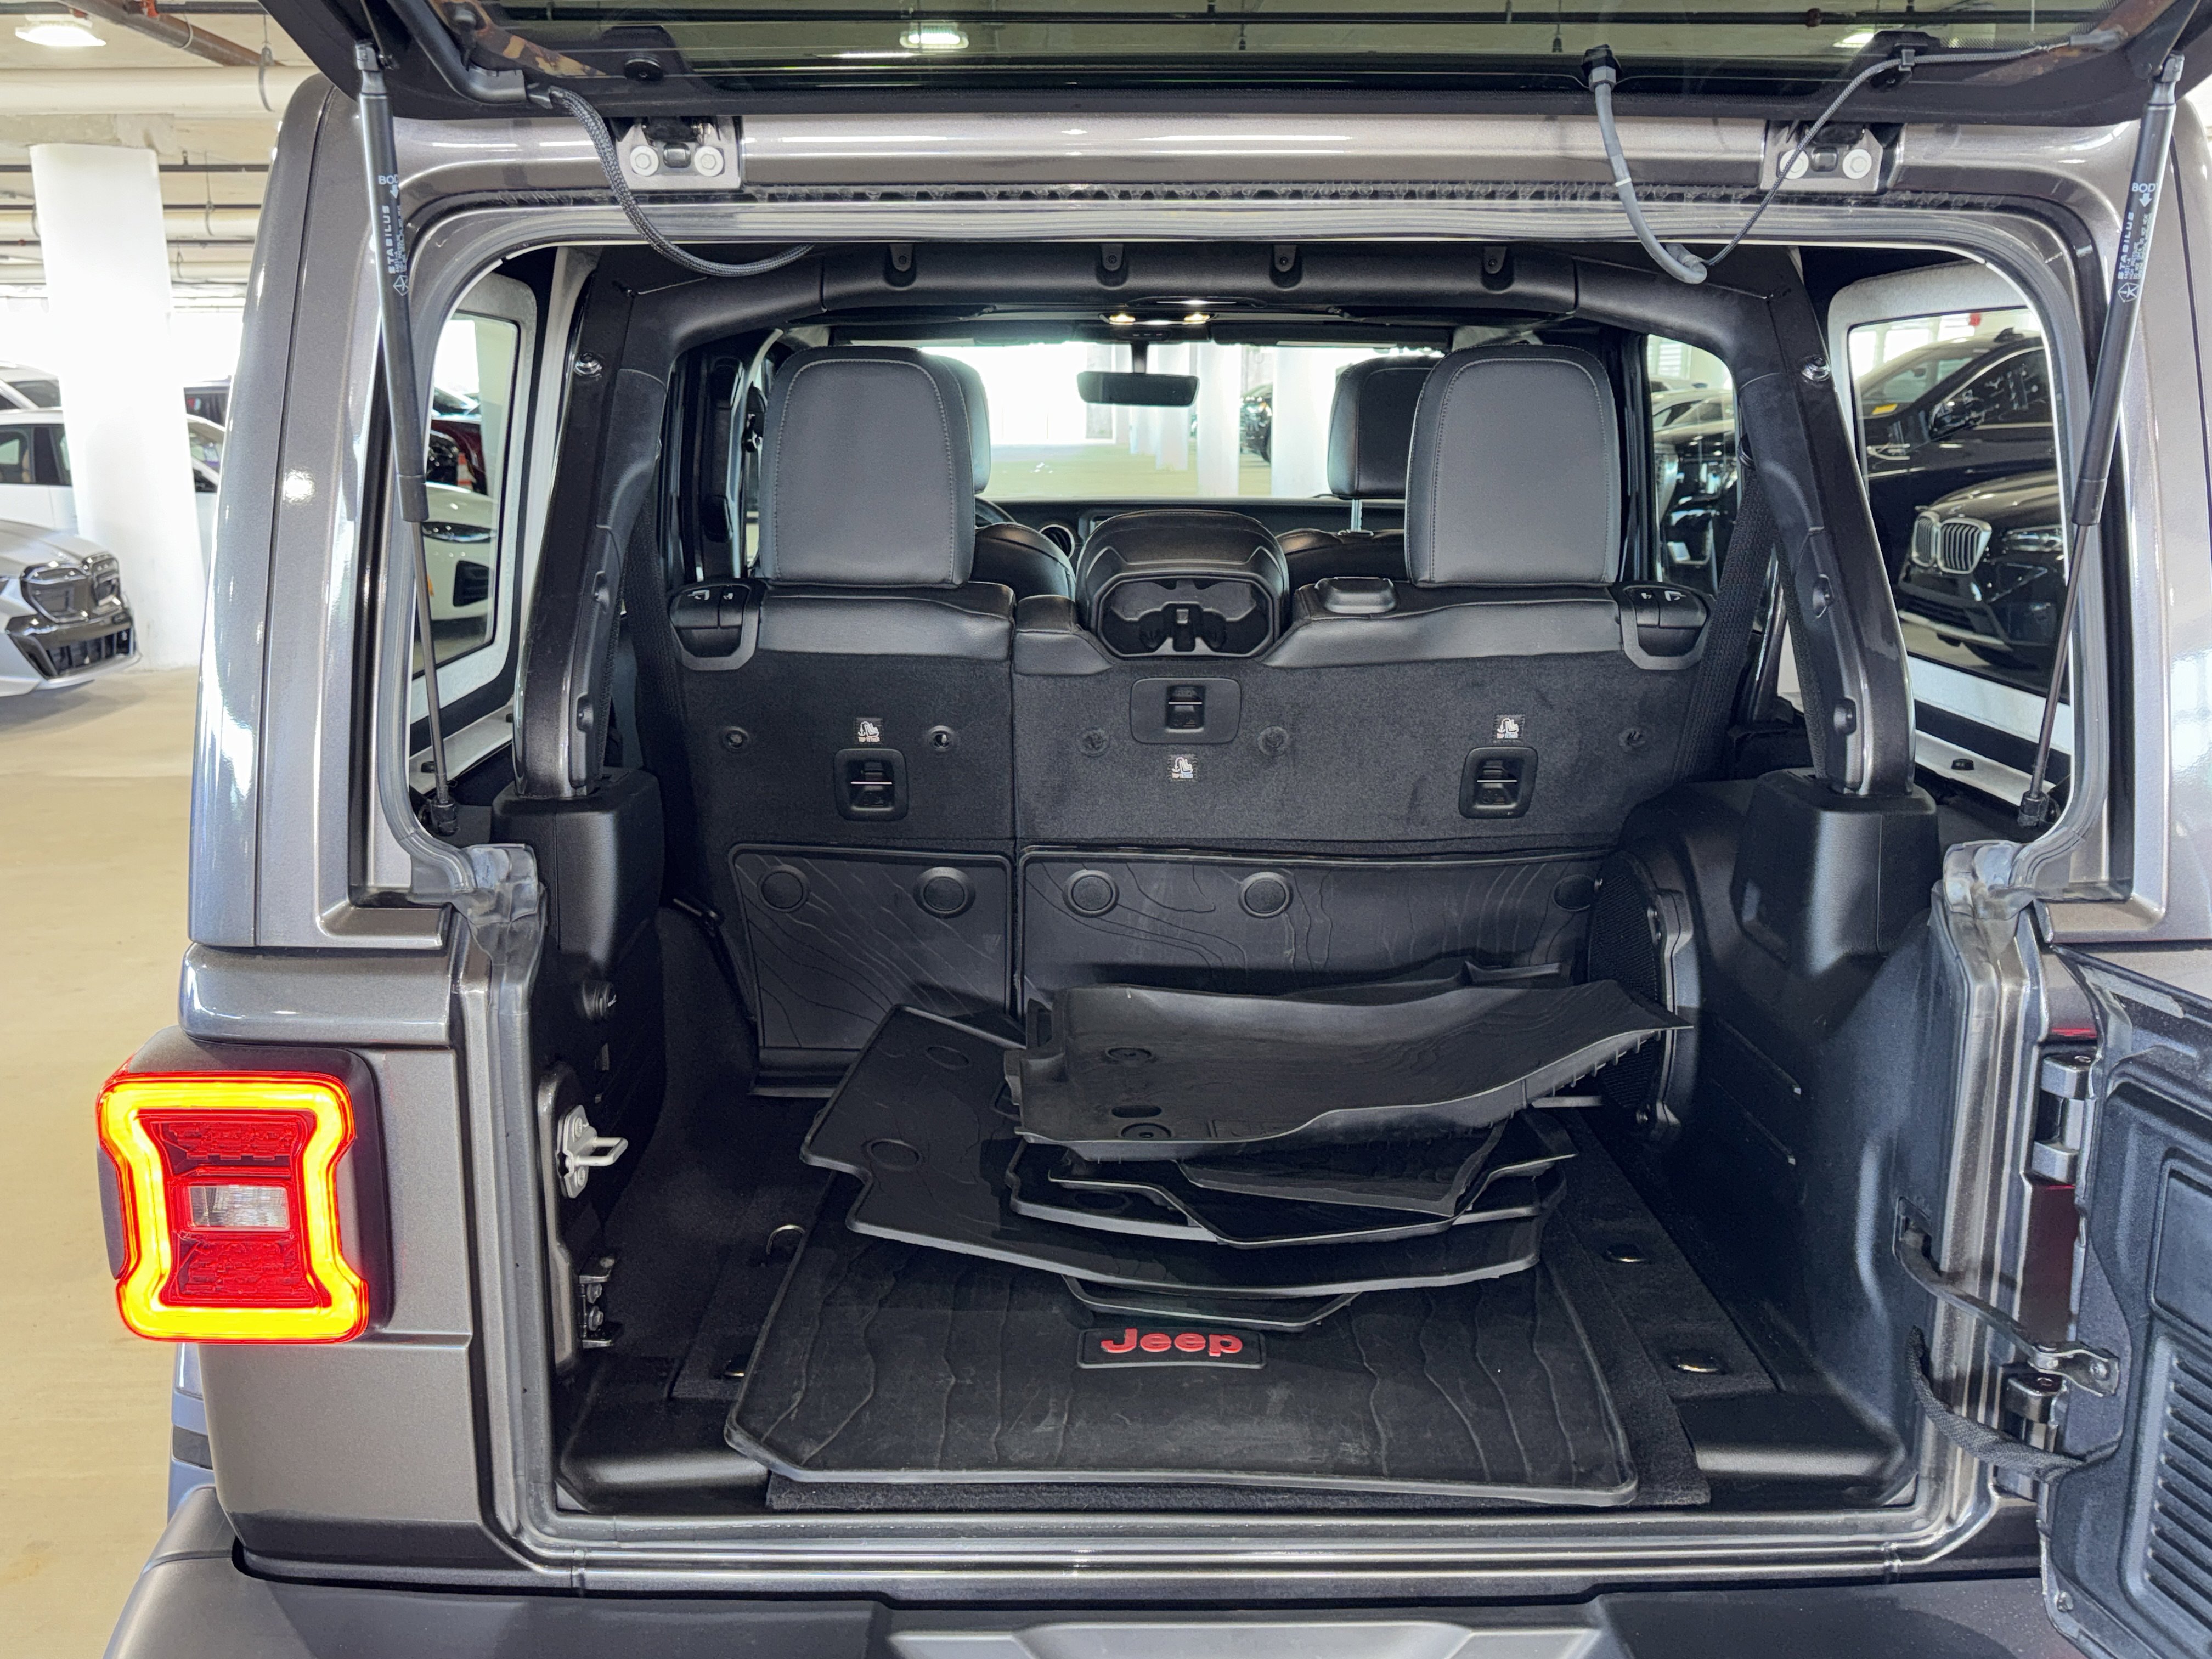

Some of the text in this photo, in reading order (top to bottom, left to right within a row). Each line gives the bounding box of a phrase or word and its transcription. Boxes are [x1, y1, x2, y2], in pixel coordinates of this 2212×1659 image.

[382, 205, 396, 274] STABILUS
[2118, 212, 2134, 279] STABILUS
[1101, 1328, 1243, 1357] Jeep
